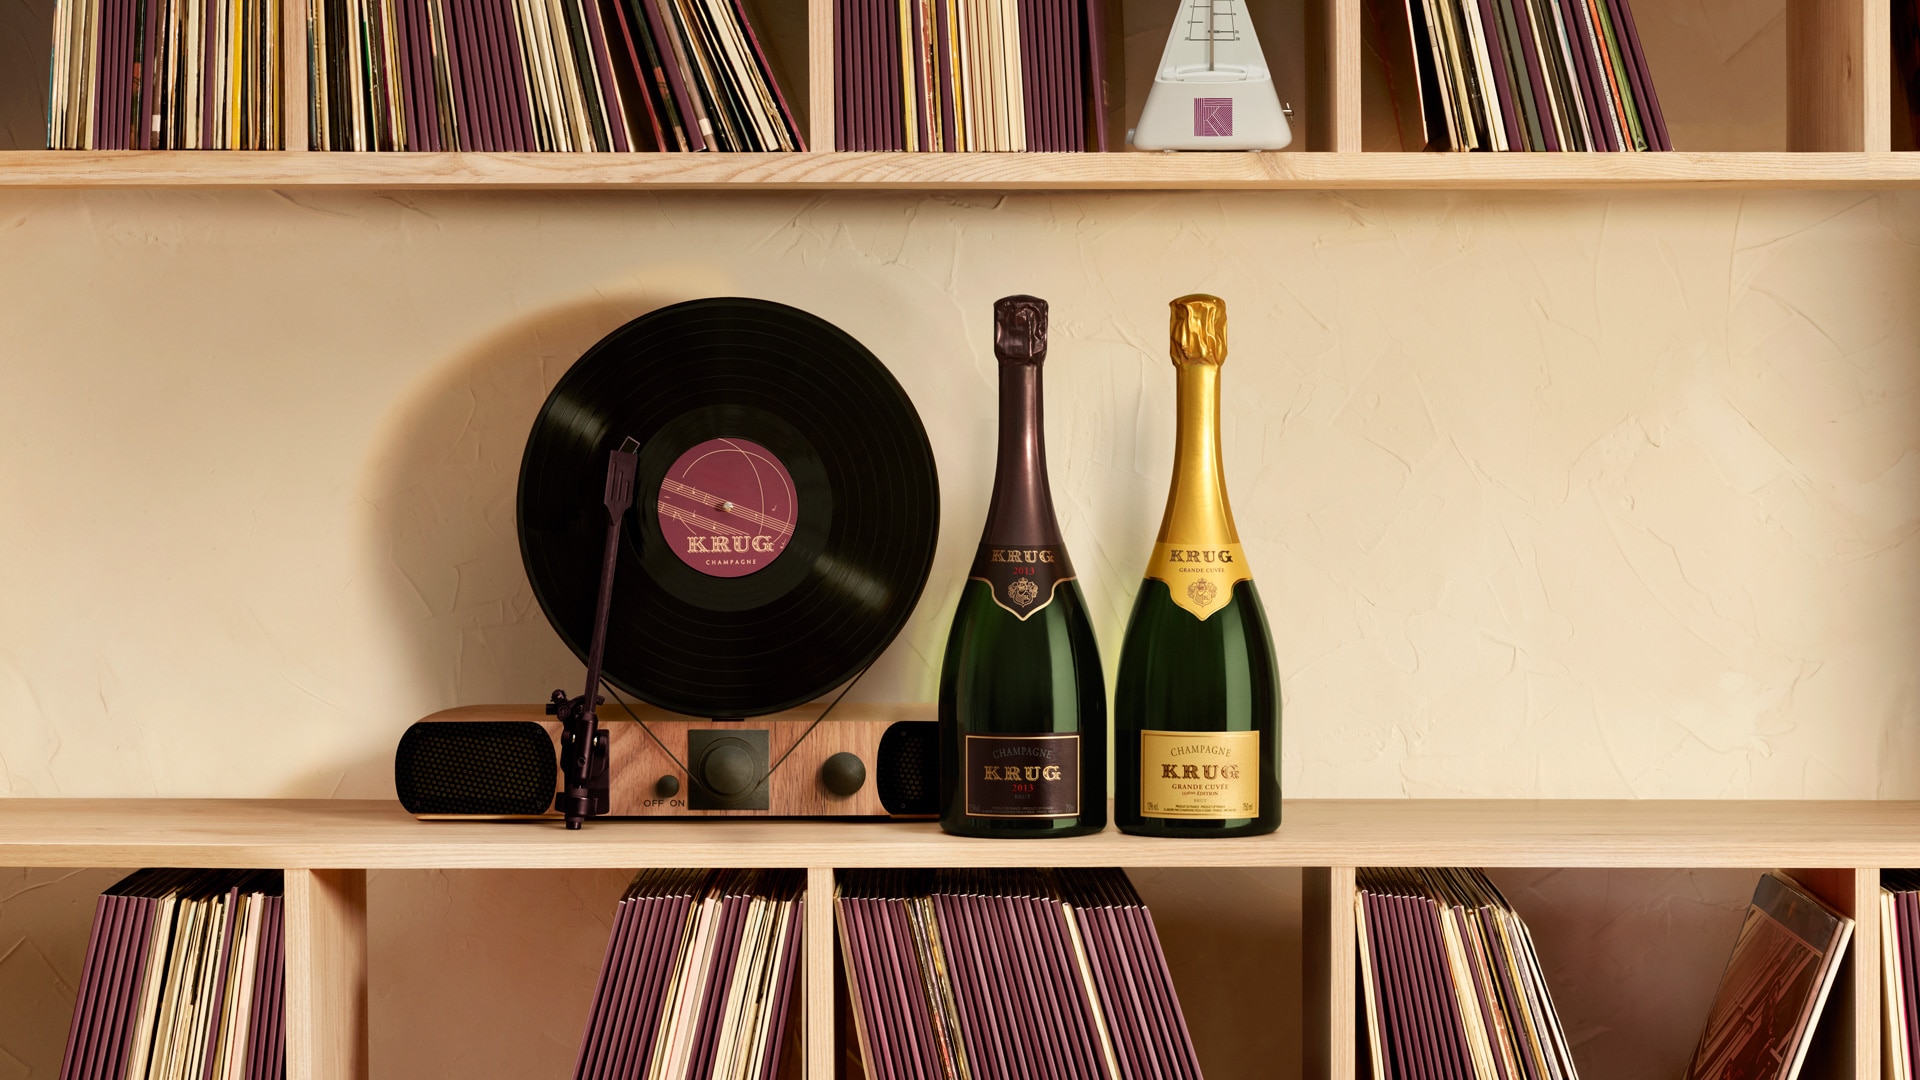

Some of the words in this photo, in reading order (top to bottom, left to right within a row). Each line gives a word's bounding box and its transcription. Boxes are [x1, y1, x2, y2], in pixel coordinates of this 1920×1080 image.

[687, 535, 774, 553] KRUG
[991, 549, 1055, 563] KRUG
[1169, 549, 1233, 563] KRUG
[1013, 566, 1035, 575] 2013
[992, 746, 1053, 759] CHAMPAGNE
[1170, 744, 1231, 758] CHAMPAGNE
[984, 765, 1061, 781] KRUG
[1161, 763, 1240, 780] KRUG
[1012, 783, 1034, 792] 2013
[1205, 782, 1229, 790] CUVÉE
